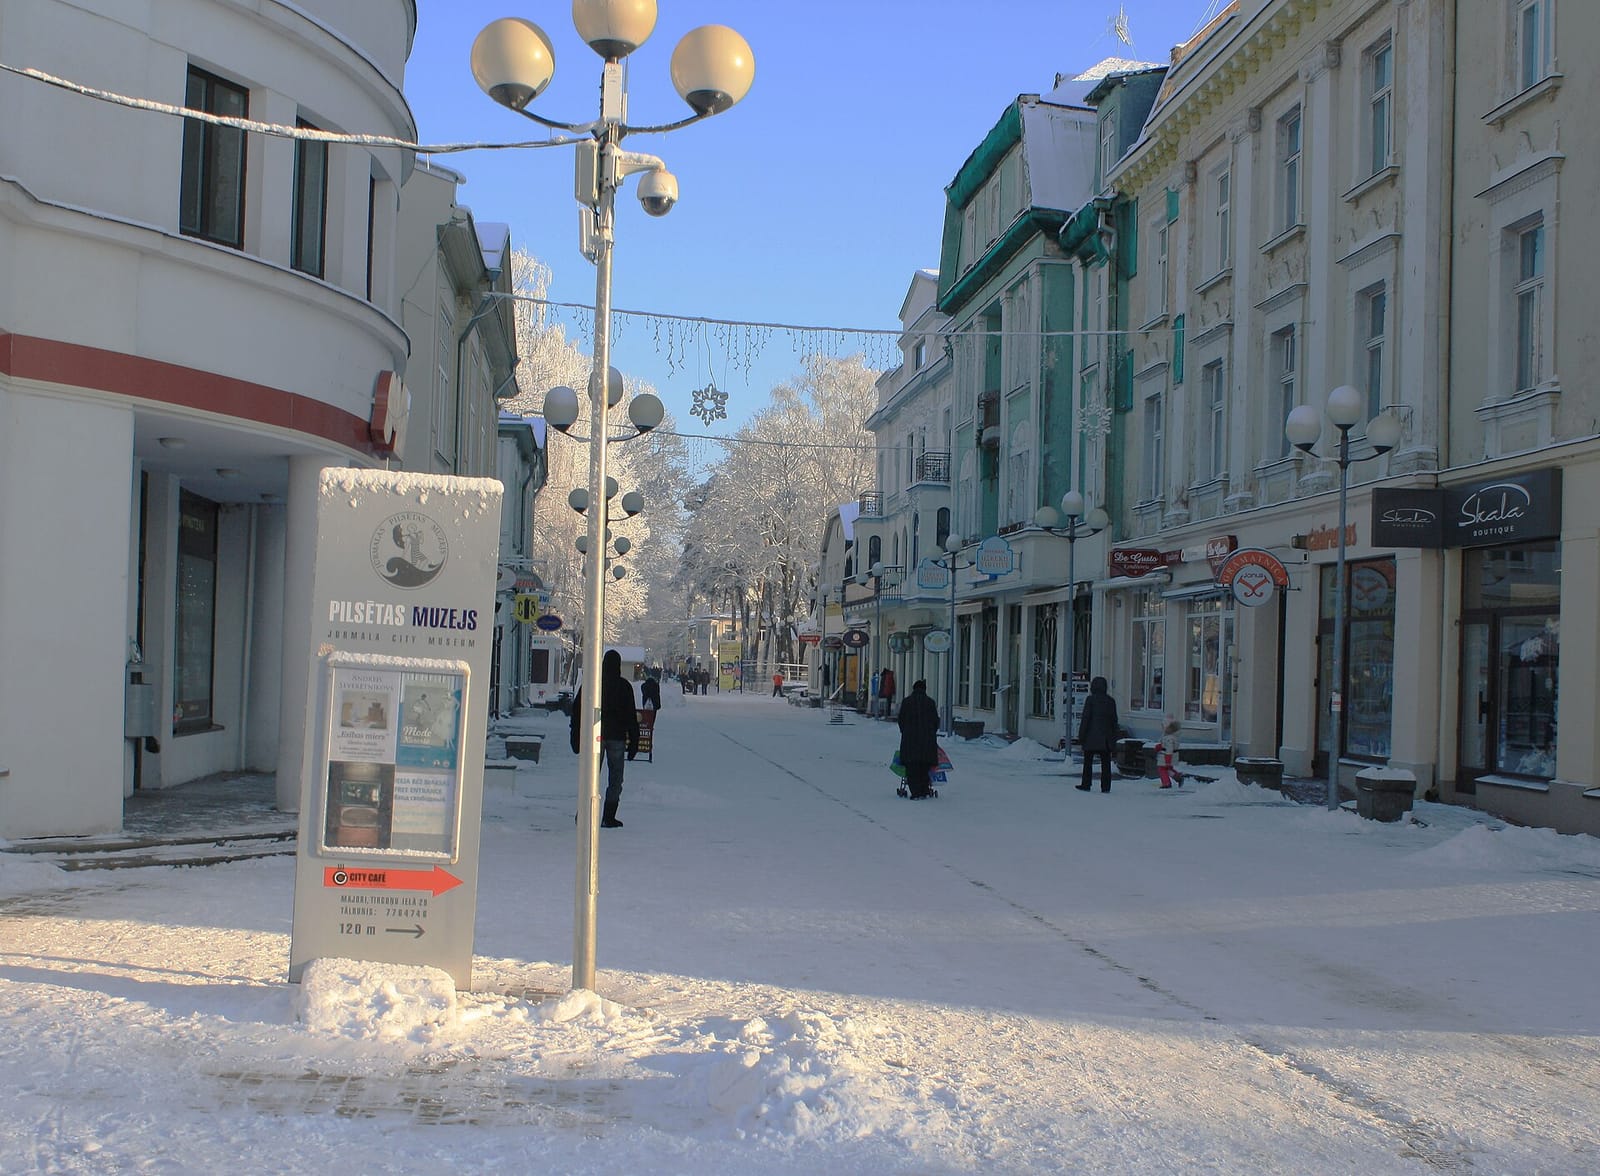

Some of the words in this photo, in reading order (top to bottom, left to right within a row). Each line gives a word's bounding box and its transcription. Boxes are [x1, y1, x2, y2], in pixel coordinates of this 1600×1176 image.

[1458, 483, 1530, 527] Skala
[1380, 508, 1436, 523] Skala
[1473, 526, 1515, 536] BOUTIQUE
[1113, 552, 1129, 562] De
[1130, 552, 1158, 563] Gusto
[329, 600, 406, 626] PILSĒTAS
[412, 606, 478, 631] MUZEJS
[391, 634, 417, 645] CITY
[428, 636, 476, 648] MUSEUM
[349, 873, 367, 882] CITY
[368, 871, 386, 883] CAFÉ
[340, 923, 362, 935] 120
[366, 925, 376, 936] m
